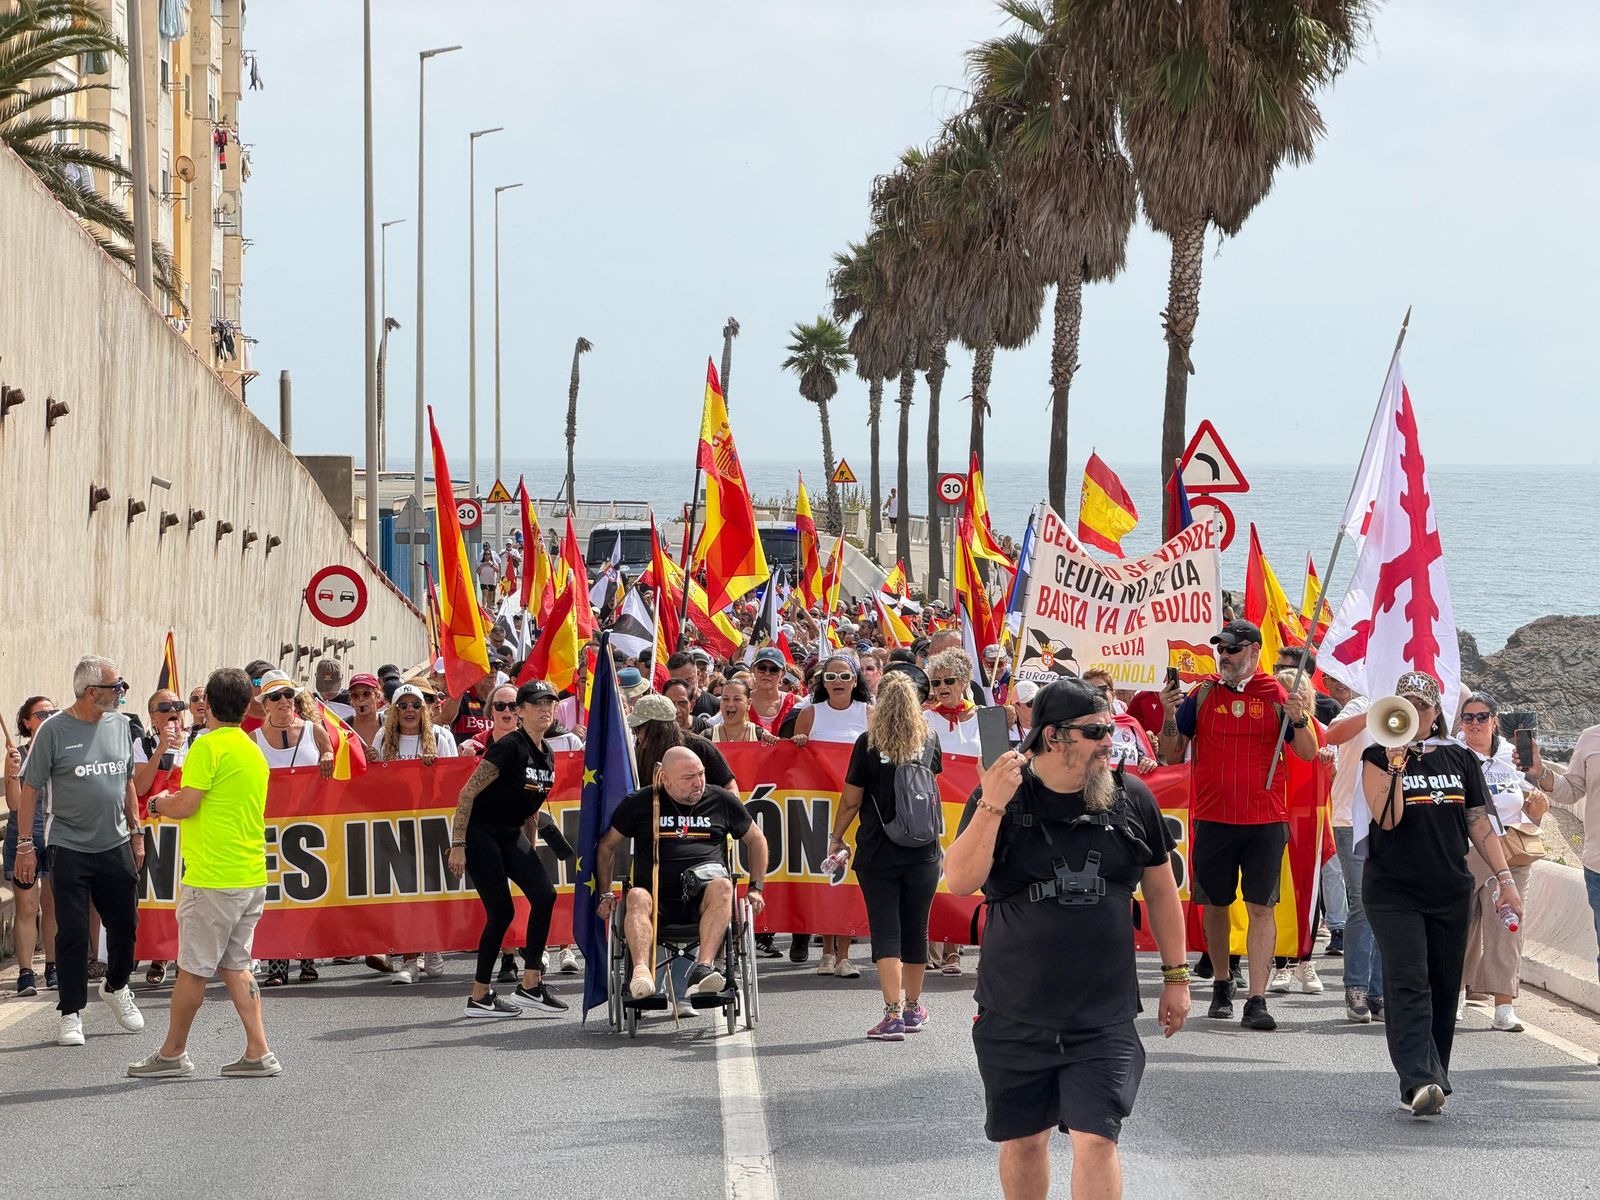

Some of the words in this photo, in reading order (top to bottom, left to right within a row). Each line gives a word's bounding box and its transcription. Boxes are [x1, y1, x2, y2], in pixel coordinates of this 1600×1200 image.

[944, 484, 960, 494] 30
[459, 510, 475, 519] 30
[1122, 560, 1153, 578] SE
[1152, 520, 1215, 563] VENDE
[1055, 554, 1114, 602] CEUTA
[1120, 577, 1149, 603] NO
[1149, 567, 1170, 597] SE
[1036, 585, 1088, 630] BASTA
[1095, 605, 1120, 635] YA
[1124, 604, 1148, 635] DE
[1151, 591, 1212, 624] BULOS
[1101, 637, 1145, 656] CEUTA
[1090, 660, 1155, 684] PAÑOLA
[466, 717, 494, 731] Esp
[1402, 775, 1428, 791] SUS
[659, 816, 675, 827] US
